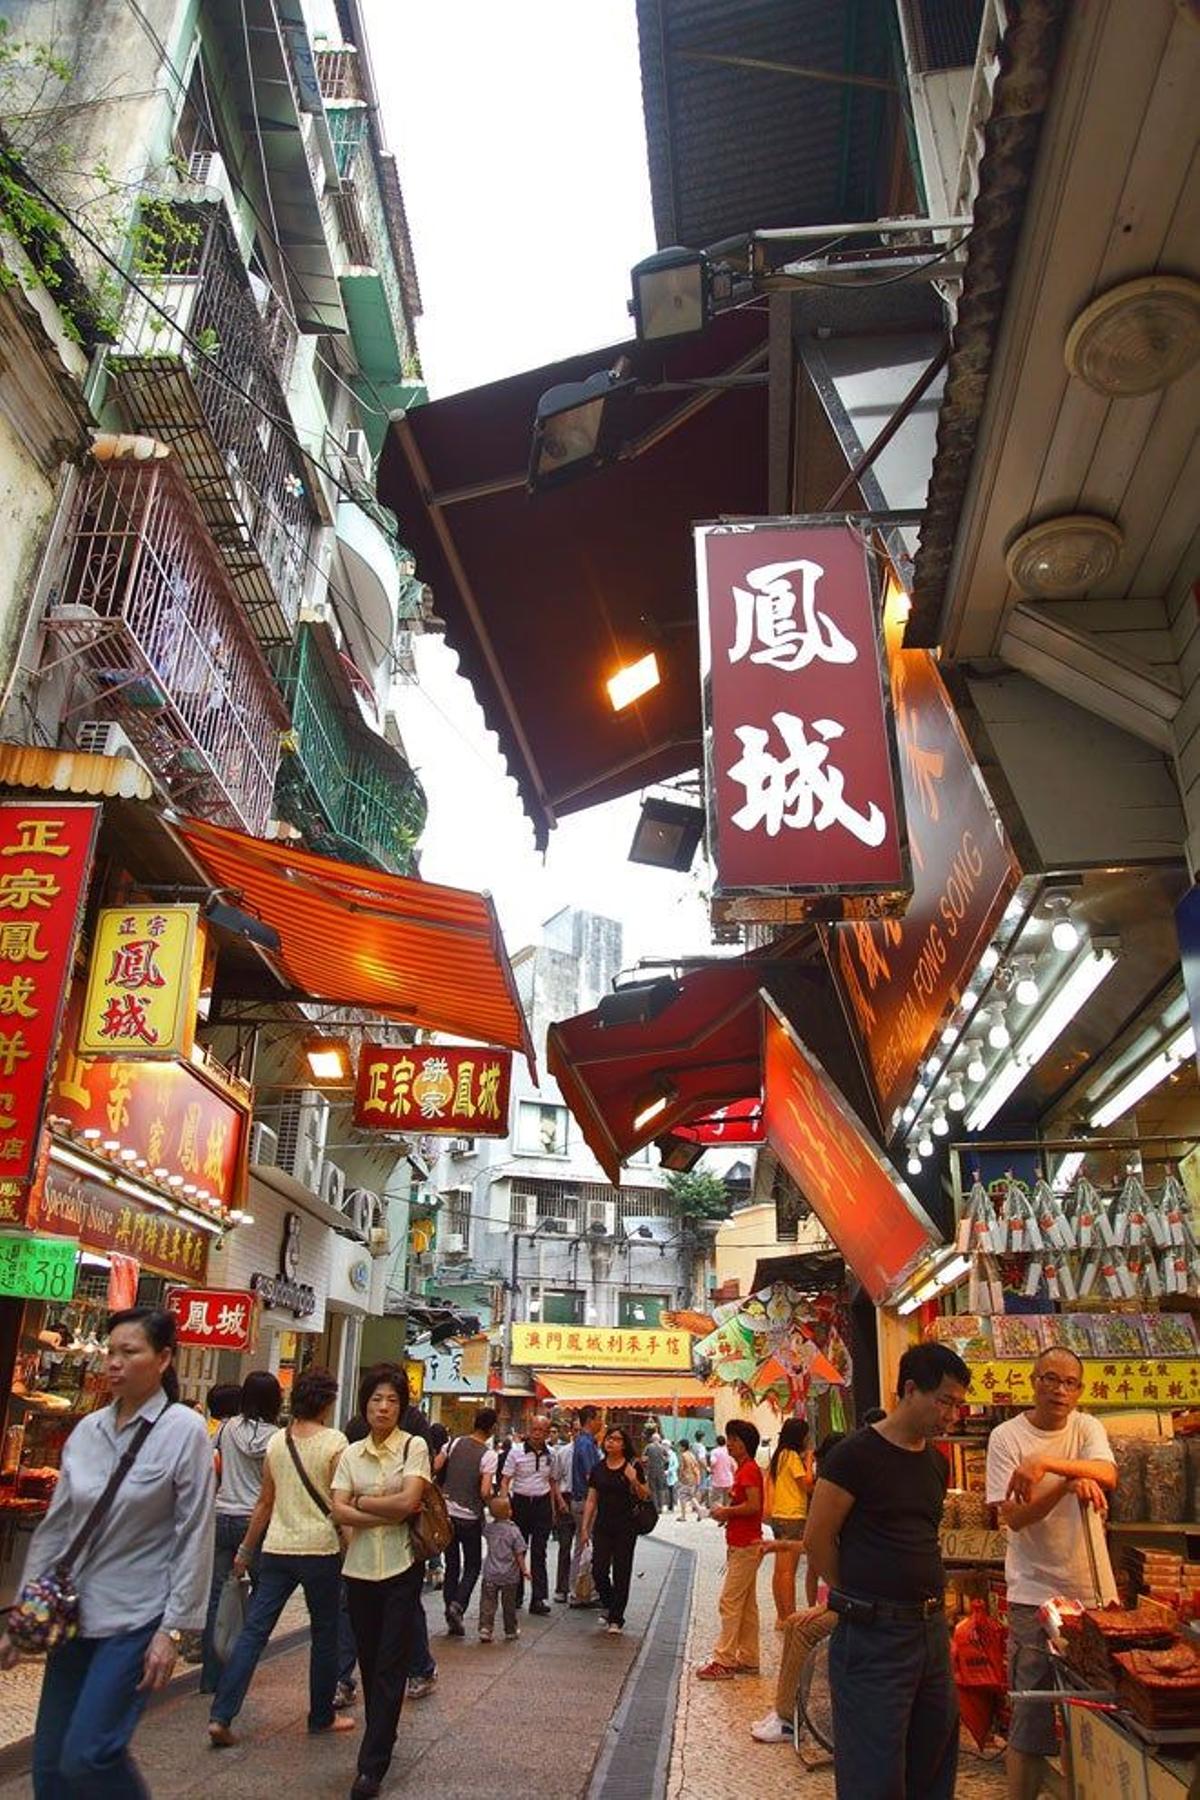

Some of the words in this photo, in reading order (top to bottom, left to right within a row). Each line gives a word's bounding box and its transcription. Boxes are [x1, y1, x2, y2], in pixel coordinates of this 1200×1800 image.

[727, 559, 886, 848] 鳳城
[118, 915, 168, 937] 正宗
[913, 917, 946, 1007] FONG
[941, 832, 984, 937] SONG
[97, 939, 166, 1047] 鳳城
[363, 1055, 416, 1118] 正宗
[419, 1057, 450, 1119] 餅家
[452, 1060, 501, 1120] 鳳城
[41, 1176, 86, 1232] Specialty
[32, 1261, 67, 1298] 38
[182, 1301, 247, 1338] 鳳城
